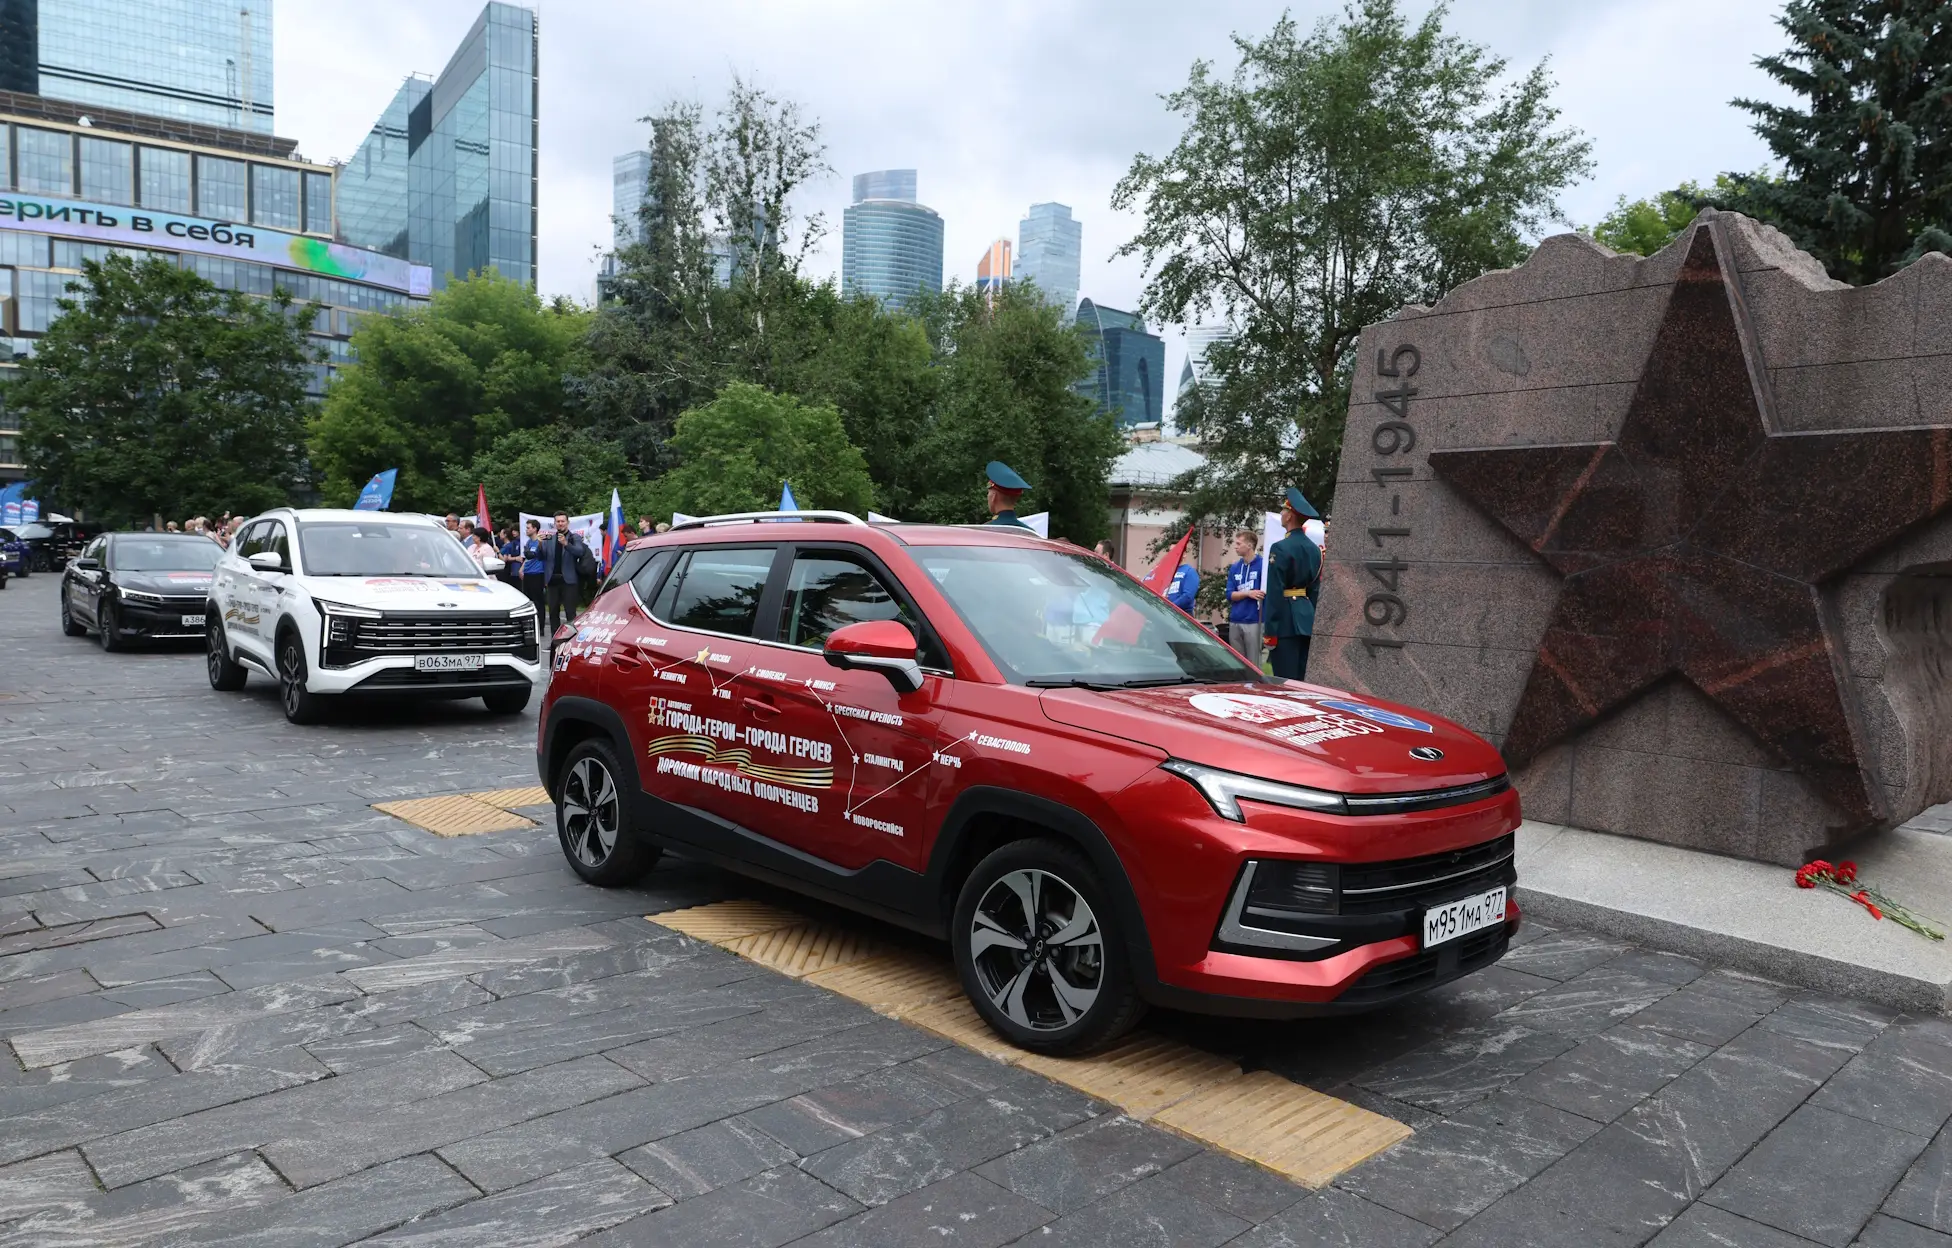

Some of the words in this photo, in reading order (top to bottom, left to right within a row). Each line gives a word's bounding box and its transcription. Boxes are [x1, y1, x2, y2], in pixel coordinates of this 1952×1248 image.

[131, 215, 154, 232] в
[165, 221, 254, 248] себя
[1361, 343, 1421, 658] 1941-1945
[419, 656, 463, 668] В063МА
[464, 655, 481, 664] 977
[834, 704, 870, 720] БРЕСТСКАЯ
[870, 712, 903, 726] КРЕПОСТЬ
[789, 736, 832, 764] ГЕРОЕВ
[977, 735, 1031, 755] СЕВАСТОПОЛЬ
[864, 753, 904, 773] СТАЛИНГРАД
[940, 753, 962, 769] КЕРЧЬ
[657, 756, 701, 782] ДОРОГАМИ
[701, 767, 752, 796] НАРОДНЫХ
[754, 781, 819, 813] ОПОЛЧЕНЦЕВ
[853, 813, 904, 837] НОВОРОССИЙСК
[1429, 904, 1481, 942] М951МА
[1485, 890, 1503, 915] 977
